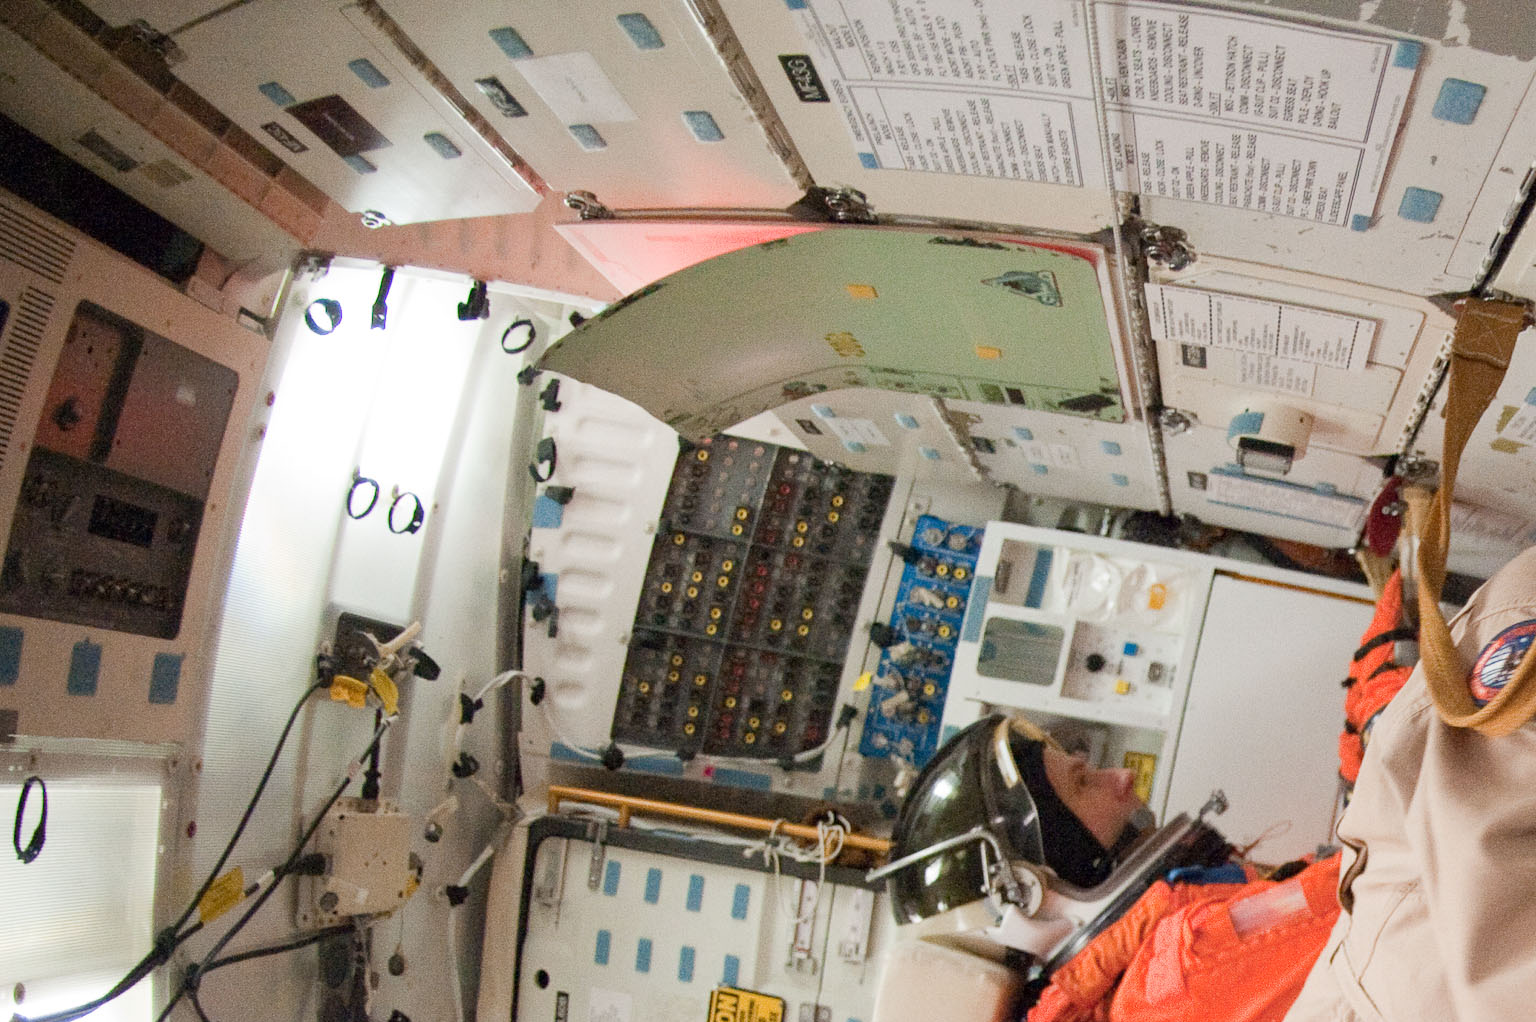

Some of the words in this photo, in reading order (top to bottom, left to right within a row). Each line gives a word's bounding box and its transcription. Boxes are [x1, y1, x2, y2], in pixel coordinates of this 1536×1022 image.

[1021, 14, 1035, 33] LOCK
[1052, 19, 1065, 37] PULL
[1129, 14, 1141, 43] LOWER
[1145, 18, 1157, 50] REMOVE
[1177, 13, 1188, 48] RELEASE
[1010, 31, 1027, 61] RELEASE
[1056, 44, 1069, 65] APPLE
[1161, 22, 1173, 68] DISCONNECT
[1226, 35, 1237, 61] HATCH
[1132, 48, 1143, 71] SEATS
[1178, 53, 1188, 89] RESTRAINT
[1193, 45, 1203, 79] UNCOVER
[1240, 43, 1253, 89] DISCONNECT
[1271, 44, 1286, 90] DISCONNECT
[788, 58, 821, 99] MF43G
[1059, 66, 1072, 88] GREEN
[1147, 56, 1159, 101] KNEEBOARDS
[1163, 74, 1174, 103] COOLING
[1224, 61, 1236, 92] JETTISON
[1286, 78, 1298, 95] SEAT
[1300, 74, 1314, 102] DEPLOY
[1317, 79, 1330, 99] HOOK
[979, 97, 994, 124] RELEASE
[1178, 89, 1188, 105] SEAT
[1283, 95, 1295, 121] EGRESS
[966, 98, 981, 126] RELEASE
[1268, 104, 1279, 119] SUIT
[1297, 107, 1309, 124] POLE
[1327, 102, 1341, 129] BAILOUT
[894, 125, 910, 151] RELEASE
[955, 109, 973, 146] DISCONNECT
[1000, 121, 1016, 158] DISCONNECT
[1013, 119, 1029, 156] DISCONNECT
[1200, 139, 1209, 163] REMOVE
[1215, 142, 1225, 177] DISCONNECT
[1230, 132, 1241, 159] RELEASE
[1246, 133, 1257, 159] RELEASE
[1141, 151, 1151, 176] RELEASE
[1258, 157, 1271, 191] DISCONNECT
[1288, 158, 1302, 193] DISCONNECT
